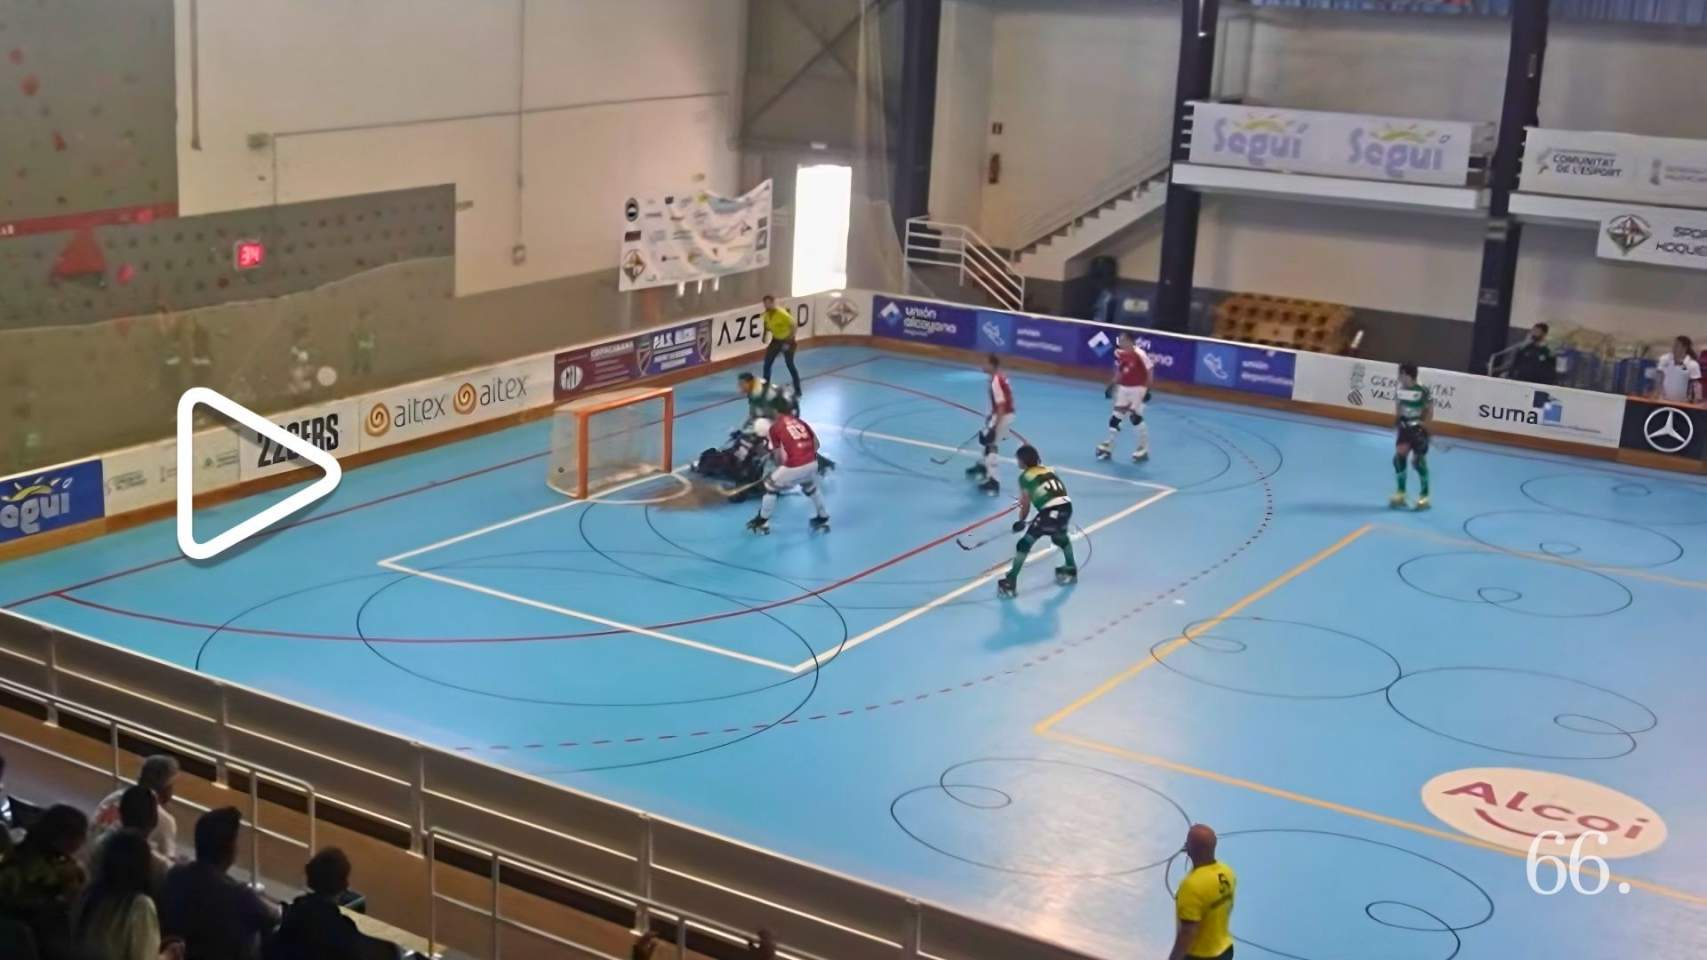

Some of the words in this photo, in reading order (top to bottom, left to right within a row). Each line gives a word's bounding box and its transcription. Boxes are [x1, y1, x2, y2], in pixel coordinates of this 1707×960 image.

[1553, 153, 1616, 167] COMUNITAT
[394, 393, 446, 428] aitex
[479, 375, 530, 407] aitex
[1479, 403, 1538, 425] suma
